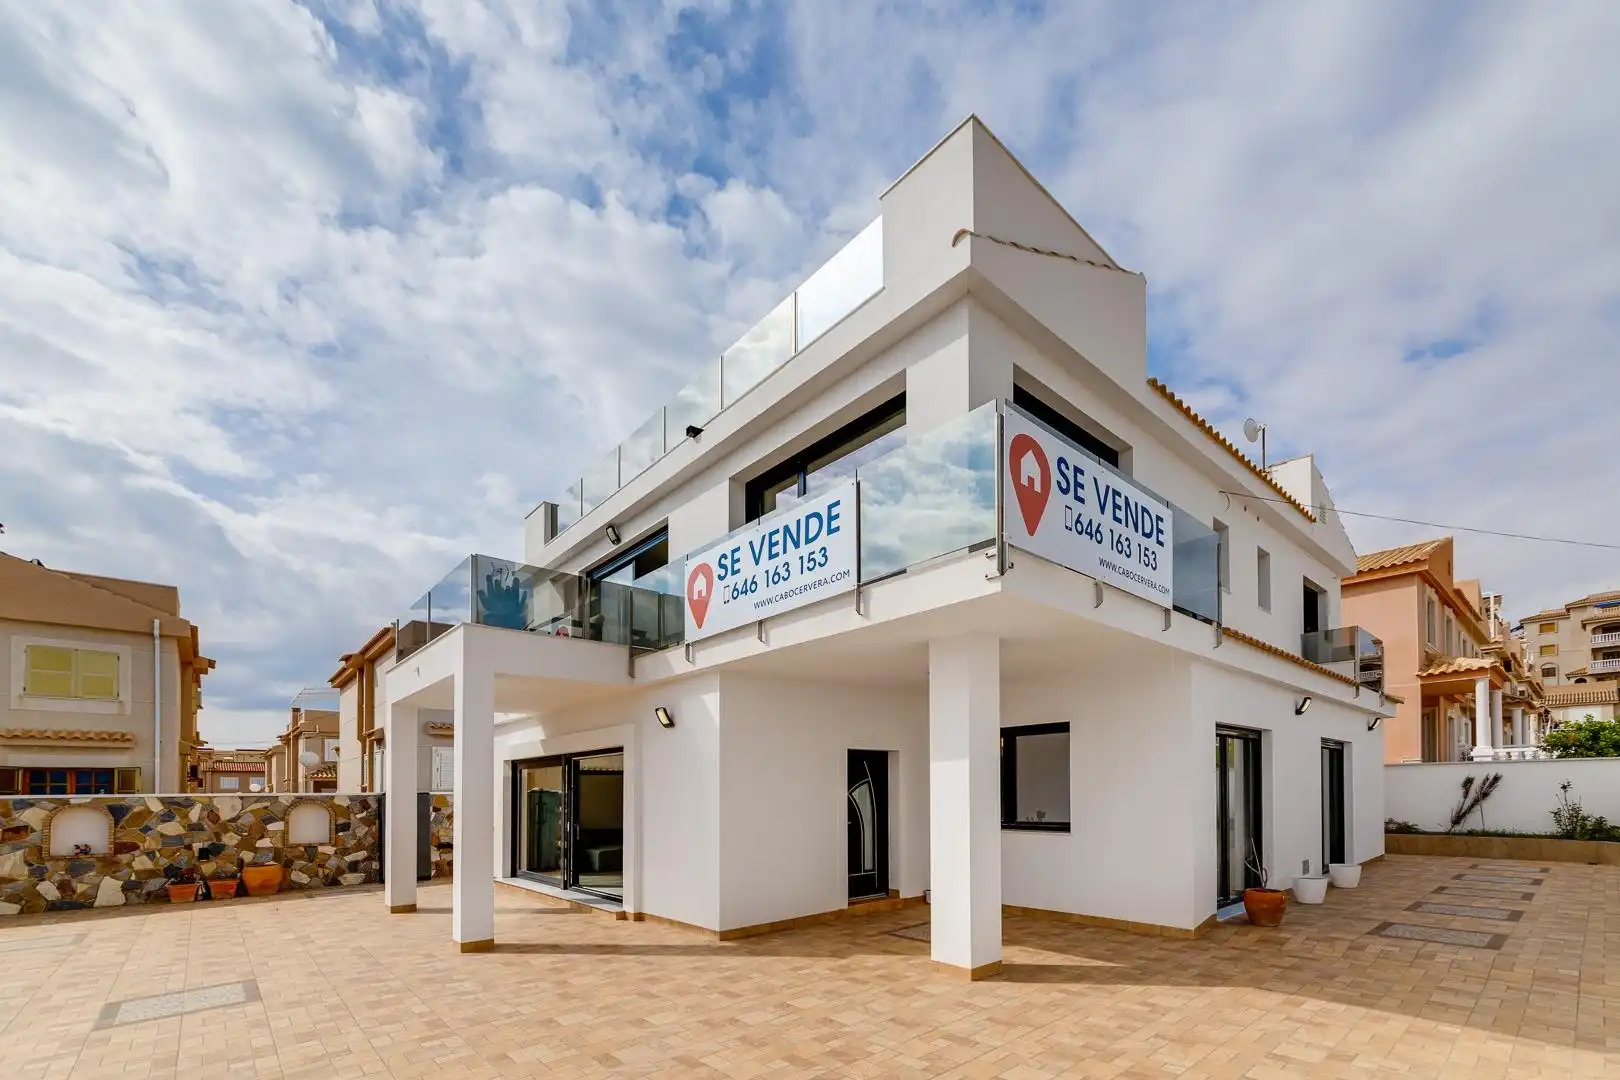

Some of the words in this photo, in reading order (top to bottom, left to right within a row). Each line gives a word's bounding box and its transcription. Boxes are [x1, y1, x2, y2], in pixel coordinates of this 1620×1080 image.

[1056, 456, 1085, 505] SE
[1093, 476, 1165, 548] VENDE
[717, 545, 741, 581] SE
[749, 500, 841, 566] VENDE
[1074, 513, 1103, 545] 646
[1109, 528, 1132, 559] 163
[1137, 543, 1158, 571] 153
[731, 574, 758, 600] 646
[765, 562, 791, 588] 163
[799, 546, 829, 575] 153
[753, 569, 850, 610] WWW.CABOCERVERA.COM
[1098, 556, 1170, 595] WWW.CABOCERVERA.COM
